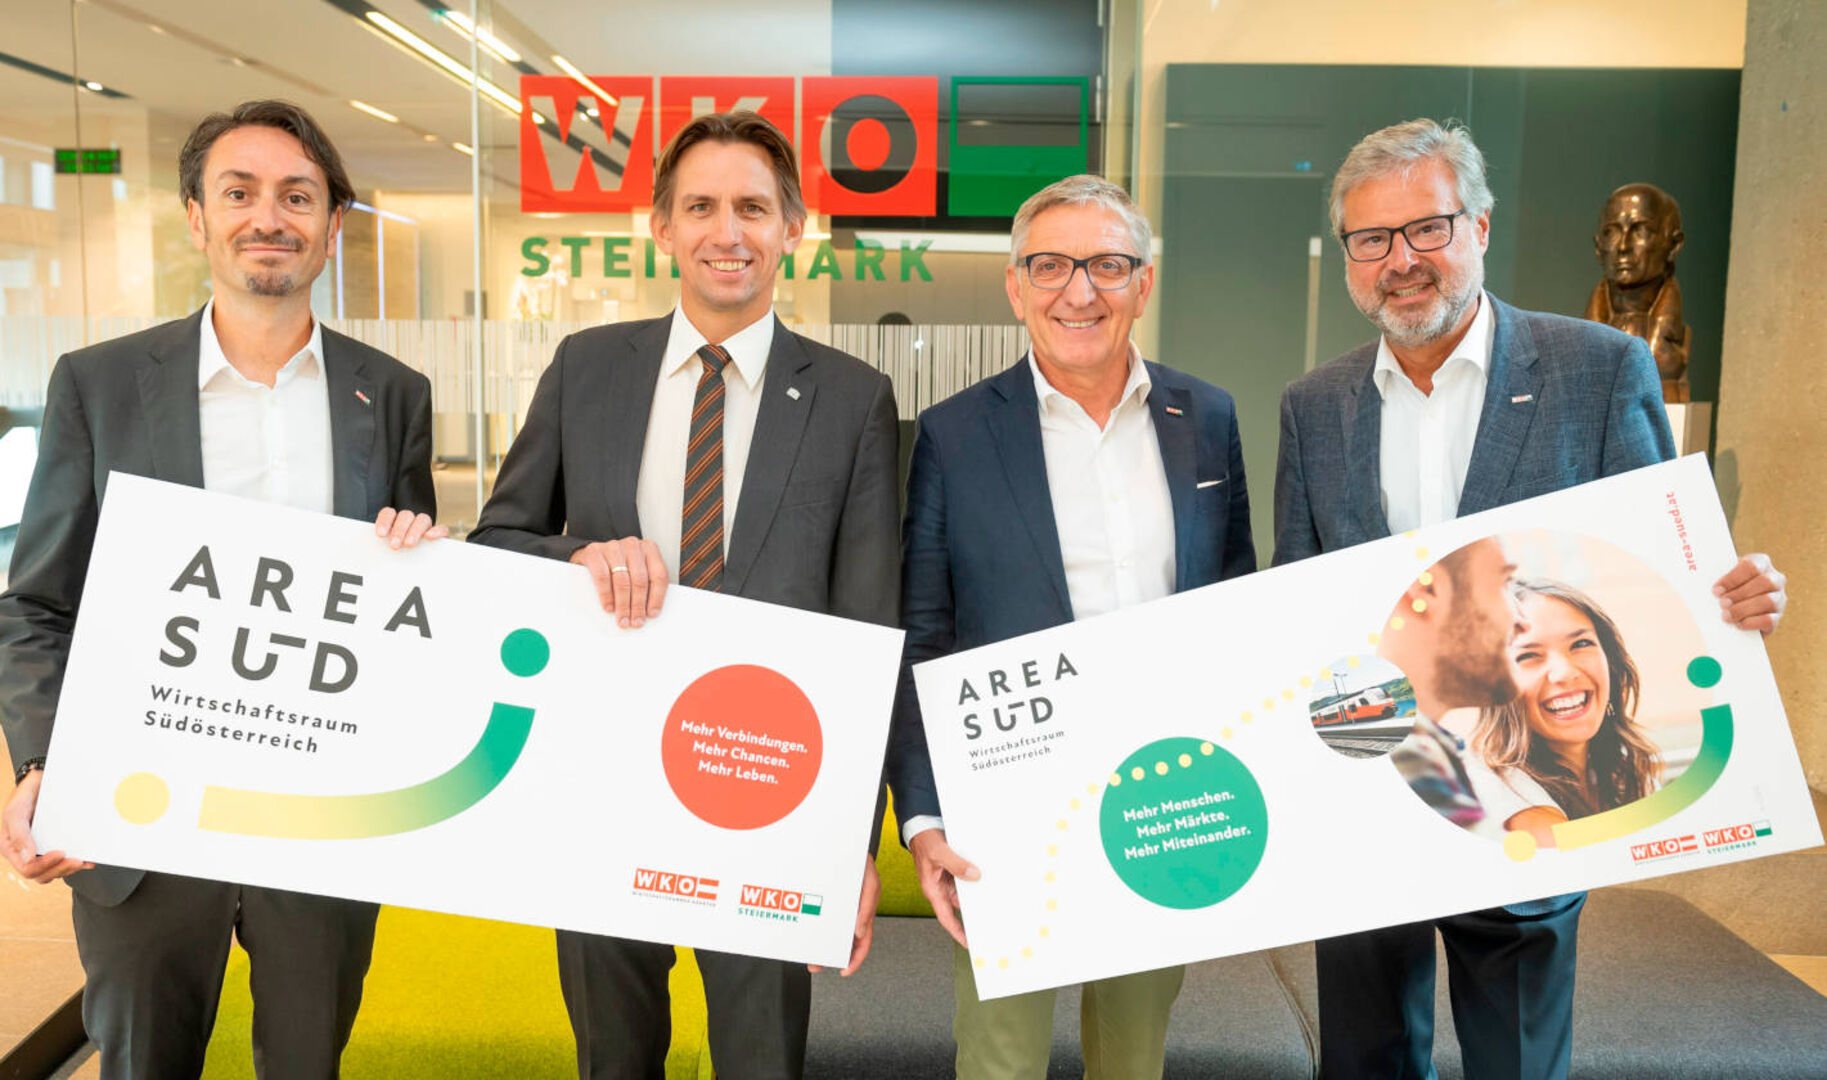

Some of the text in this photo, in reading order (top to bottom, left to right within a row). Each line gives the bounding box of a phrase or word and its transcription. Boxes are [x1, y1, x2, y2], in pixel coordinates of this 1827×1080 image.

[526, 92, 919, 196] WO
[521, 237, 934, 282] STEIARK
[169, 545, 432, 639] AREA
[958, 652, 1079, 706] AREA
[151, 684, 358, 735] Wirtschaftsraum
[144, 710, 318, 753] Südösterreich
[681, 720, 808, 753] Mehr Verbindungen.
[969, 730, 1065, 758] Wirtschaftsraum
[693, 740, 790, 769] Mehr Chancen.
[971, 746, 1051, 771] Südösterreich
[698, 760, 779, 784] Mehr Leben.
[1123, 791, 1235, 822] Mehr Menschen.
[1136, 810, 1230, 839] Mehr Märkte.
[1704, 825, 1754, 847] WKO
[1124, 825, 1252, 860] Mehr Miteinander.
[1632, 839, 1680, 859] WKO
[635, 870, 696, 895] WKO
[742, 886, 800, 910] WKO
[738, 907, 799, 923] STEIERMARK
